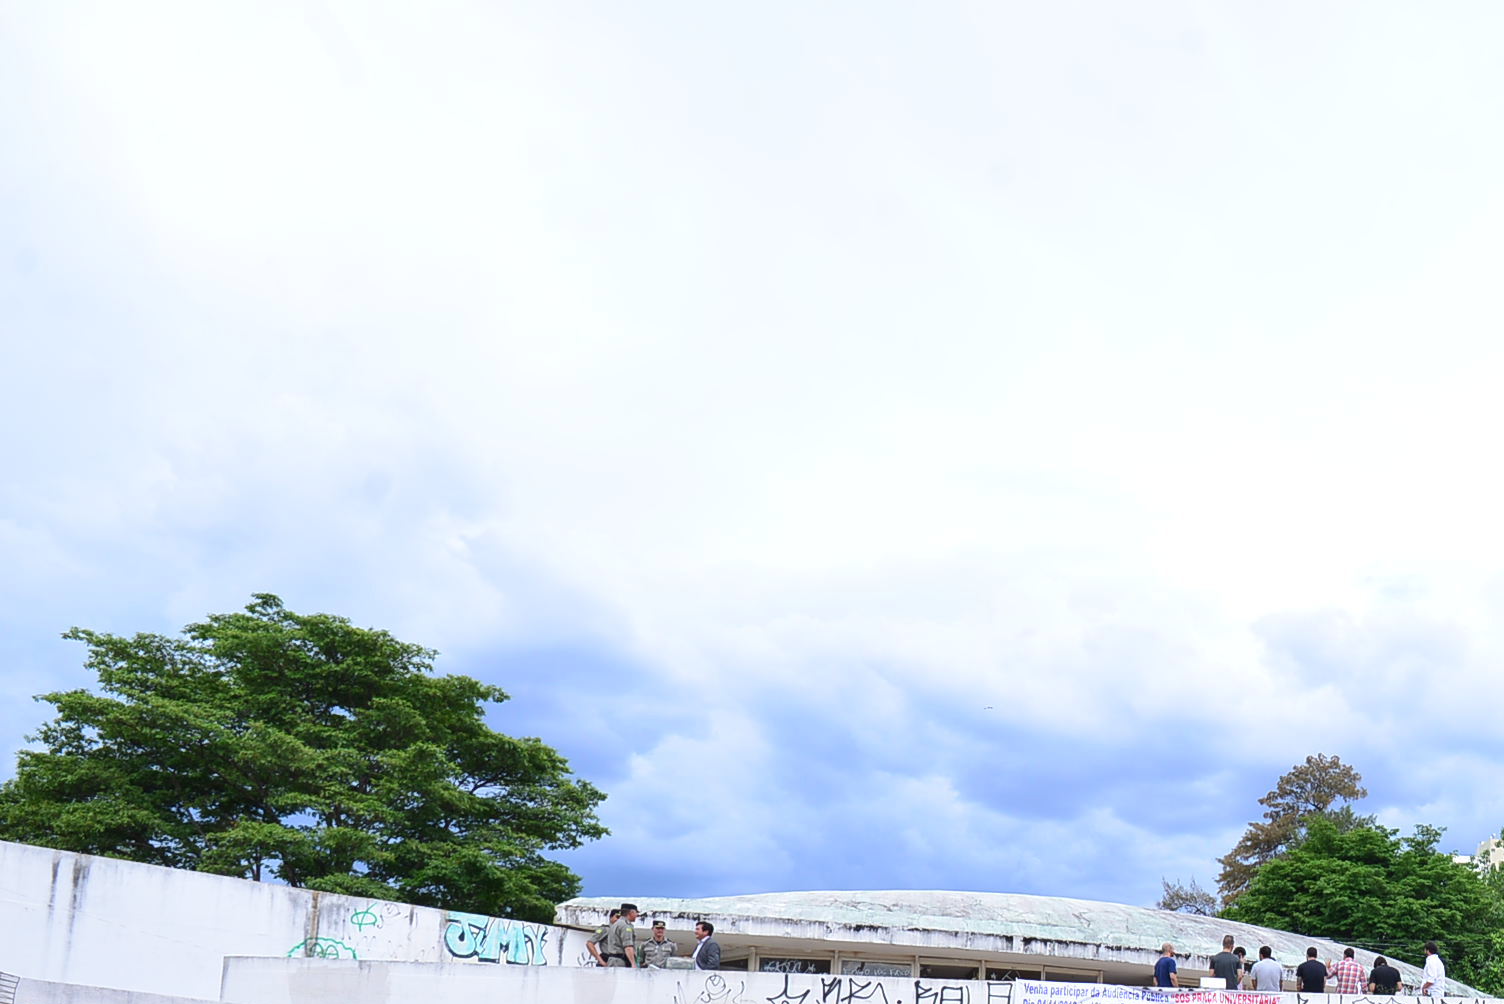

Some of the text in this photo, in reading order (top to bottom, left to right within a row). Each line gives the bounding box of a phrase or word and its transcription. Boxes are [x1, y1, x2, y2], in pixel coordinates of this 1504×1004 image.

[1024, 983, 1048, 995] Venha
[1050, 986, 1089, 999] participar
[1091, 987, 1100, 997] da
